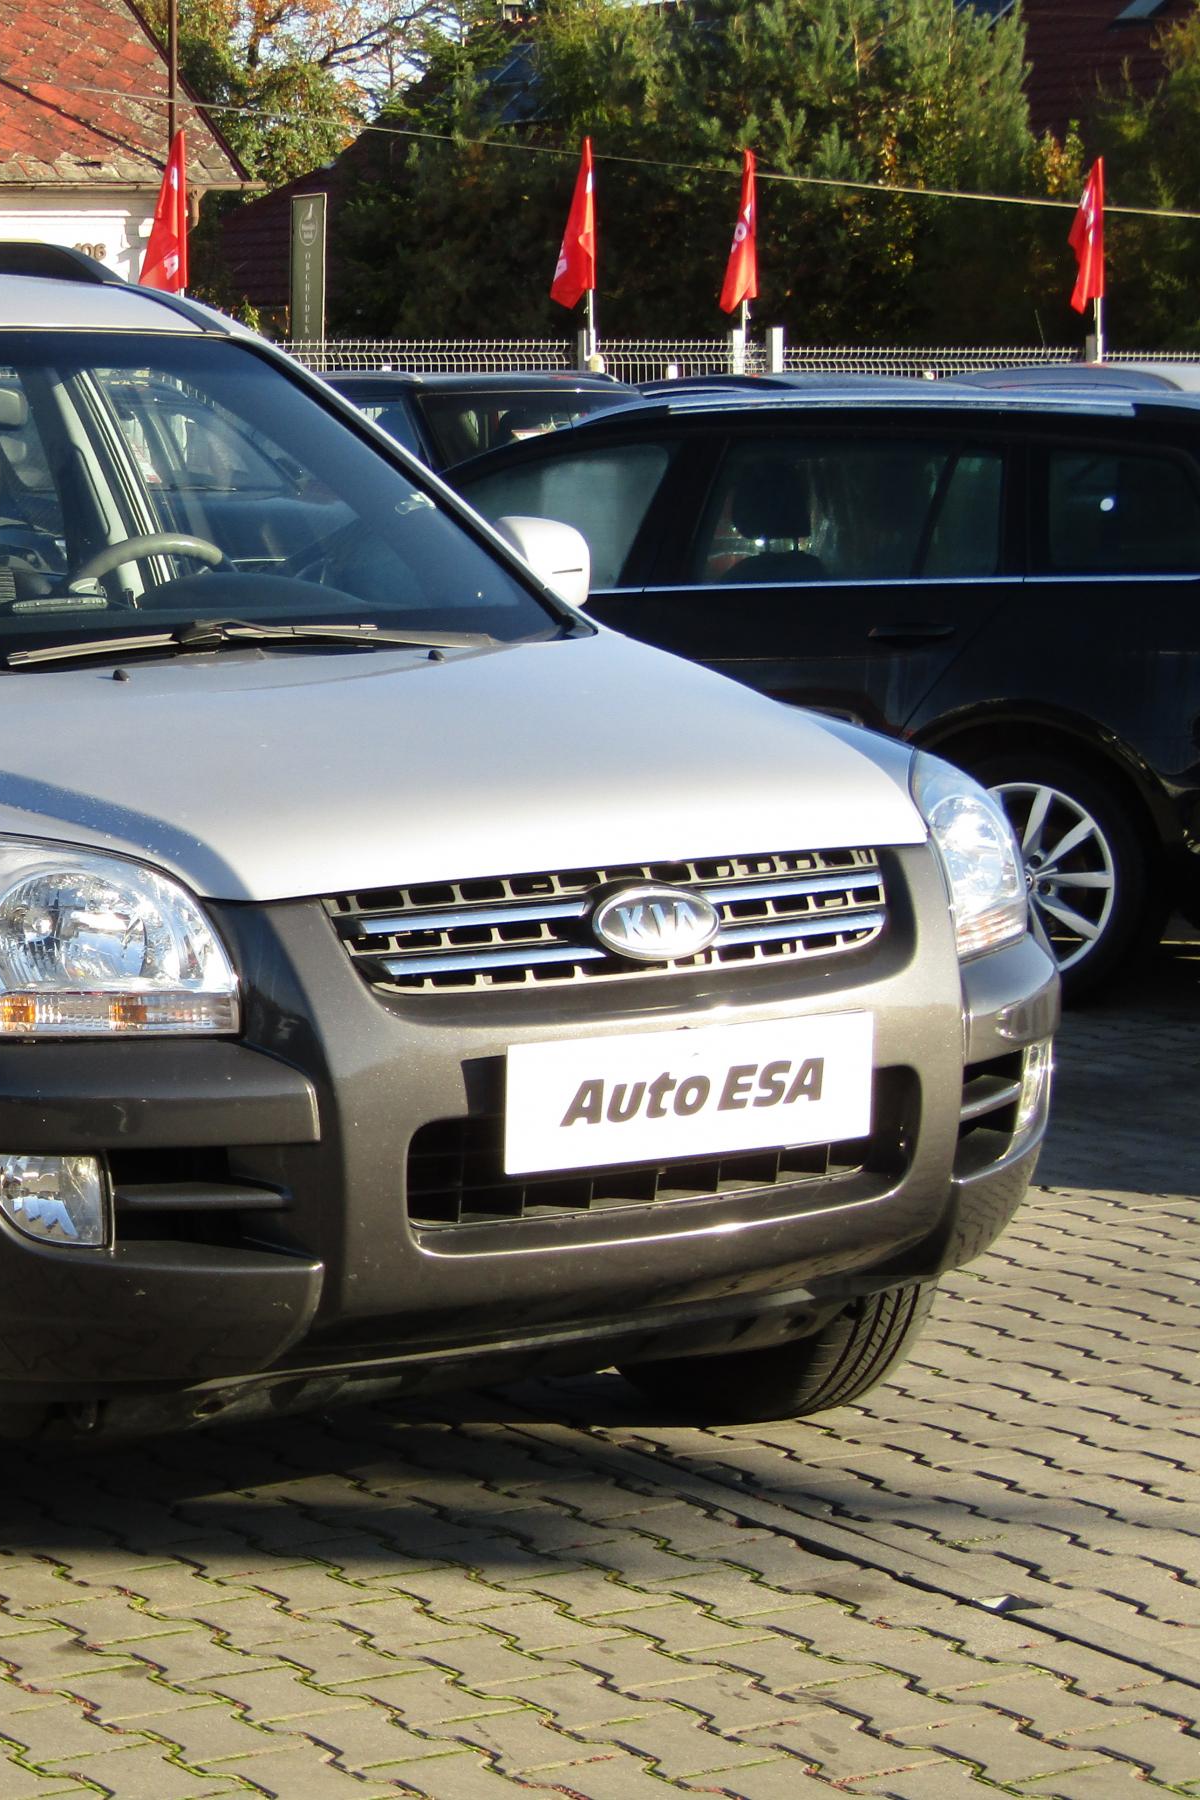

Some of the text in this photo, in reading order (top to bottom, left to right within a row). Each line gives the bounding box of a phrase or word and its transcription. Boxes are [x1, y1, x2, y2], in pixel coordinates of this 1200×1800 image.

[73, 243, 106, 261] 06
[614, 901, 705, 941] KIA
[559, 1057, 825, 1127] Auto ESA
